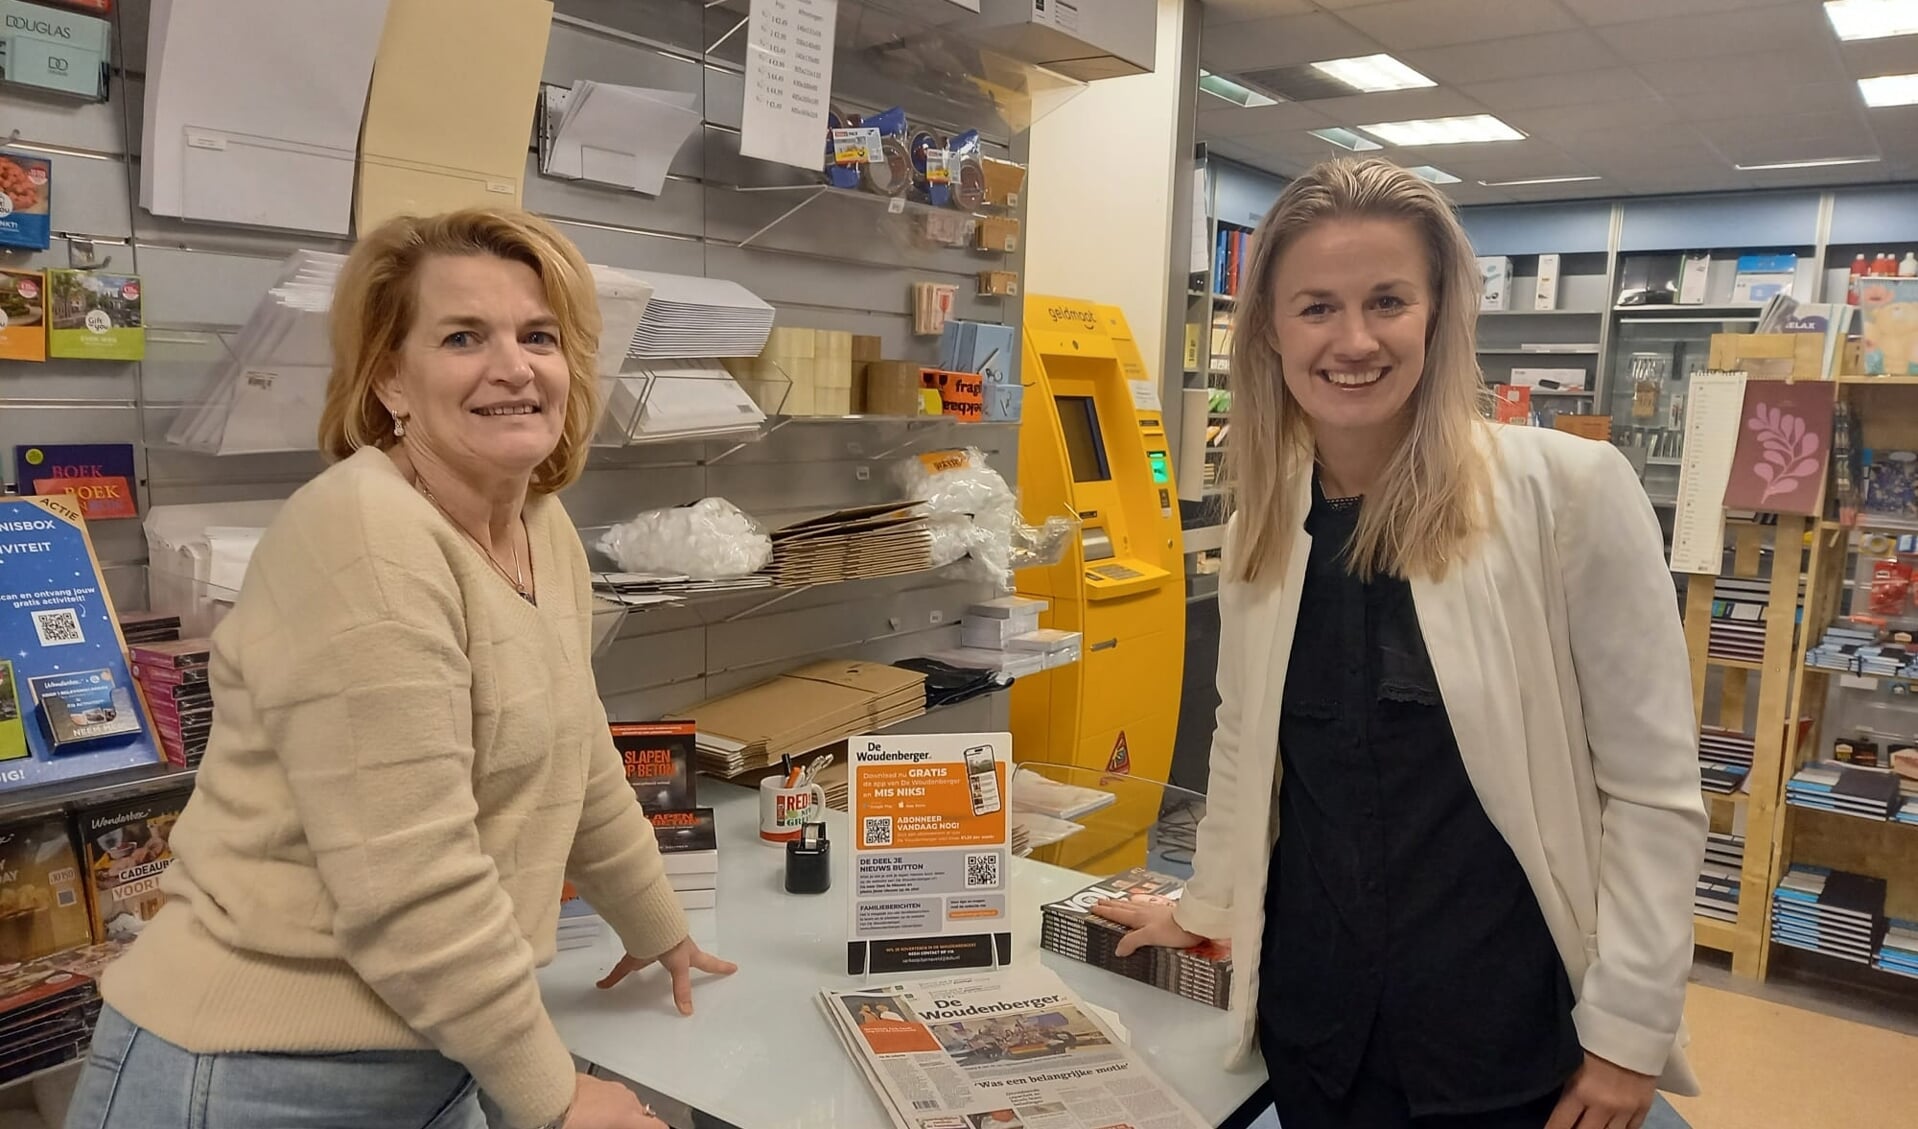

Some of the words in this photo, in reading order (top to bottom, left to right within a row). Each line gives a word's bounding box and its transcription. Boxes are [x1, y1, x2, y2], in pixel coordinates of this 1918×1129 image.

[6, 14, 70, 39] DOUGLAS
[52, 464, 104, 479] BOEK
[64, 484, 120, 500] BOEK
[40, 498, 80, 521] ACTIE
[34, 589, 72, 598] ontvang
[13, 599, 40, 608] gratis
[868, 742, 882, 752] De
[624, 750, 671, 764] SLAPEN
[637, 762, 677, 777] BETON
[908, 768, 948, 778] GRATIS
[0, 769, 25, 783] IG!
[911, 778, 961, 786] Woudenberger
[874, 788, 894, 798] MIS
[896, 788, 926, 796] NIKS!
[897, 816, 942, 824] ABONNEER
[897, 823, 938, 831] VANDAAG
[860, 864, 891, 872] NIEUWS
[0, 870, 18, 882] AY
[114, 879, 154, 898] VOOR
[860, 902, 921, 911] FAMILIEBERICHTEN
[934, 1000, 962, 1008] De
[1006, 1078, 1026, 1086] een
[1028, 1068, 1094, 1084] belangrijke
